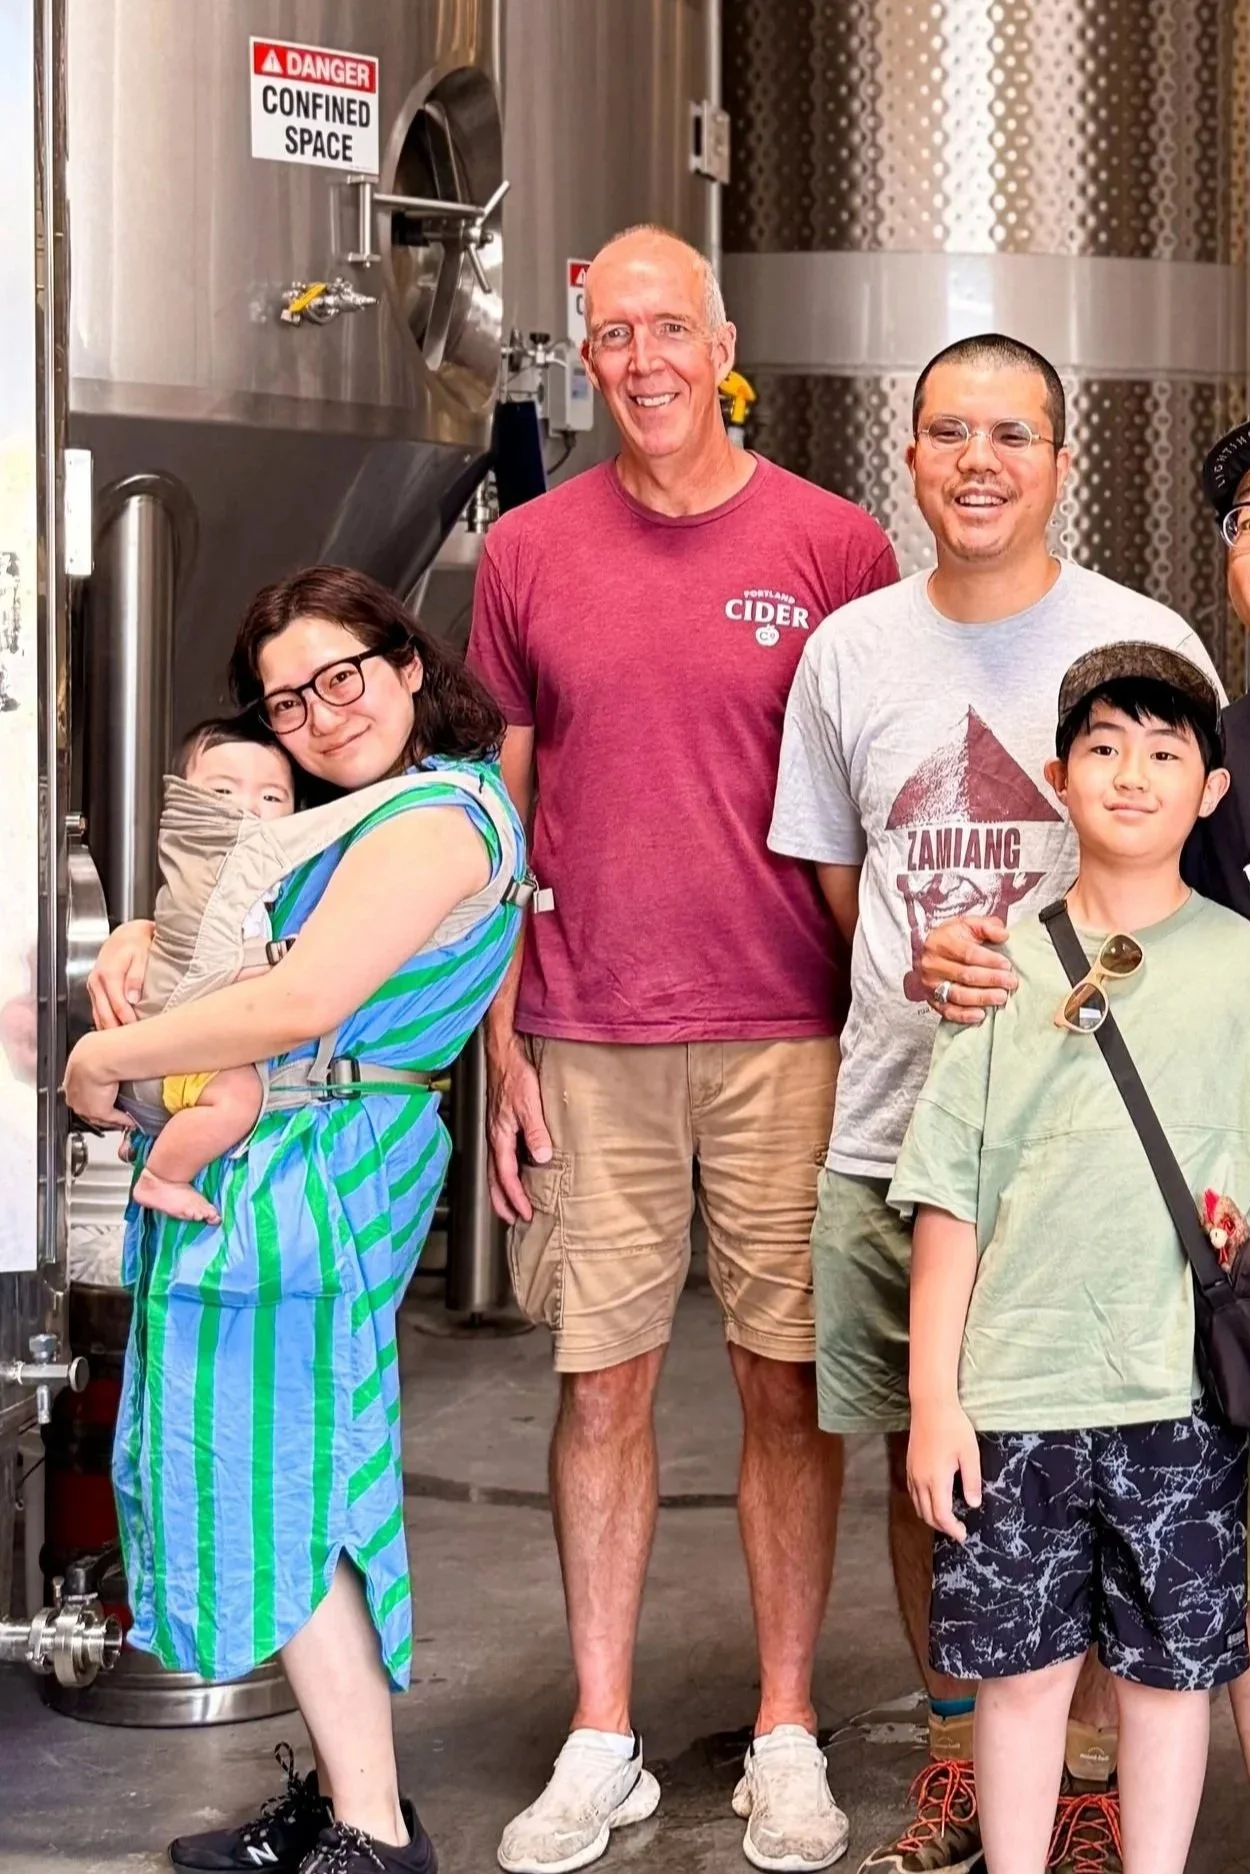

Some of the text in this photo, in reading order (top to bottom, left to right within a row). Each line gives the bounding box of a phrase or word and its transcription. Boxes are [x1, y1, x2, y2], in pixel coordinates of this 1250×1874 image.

[286, 50, 370, 89] DANGER
[262, 84, 371, 128] CONFINED
[285, 125, 353, 162] SPACE
[725, 599, 809, 630] CIDER
[743, 589, 796, 604] PORTLAND
[907, 827, 1021, 871] ZAMIANG
[247, 1842, 279, 1866] N
